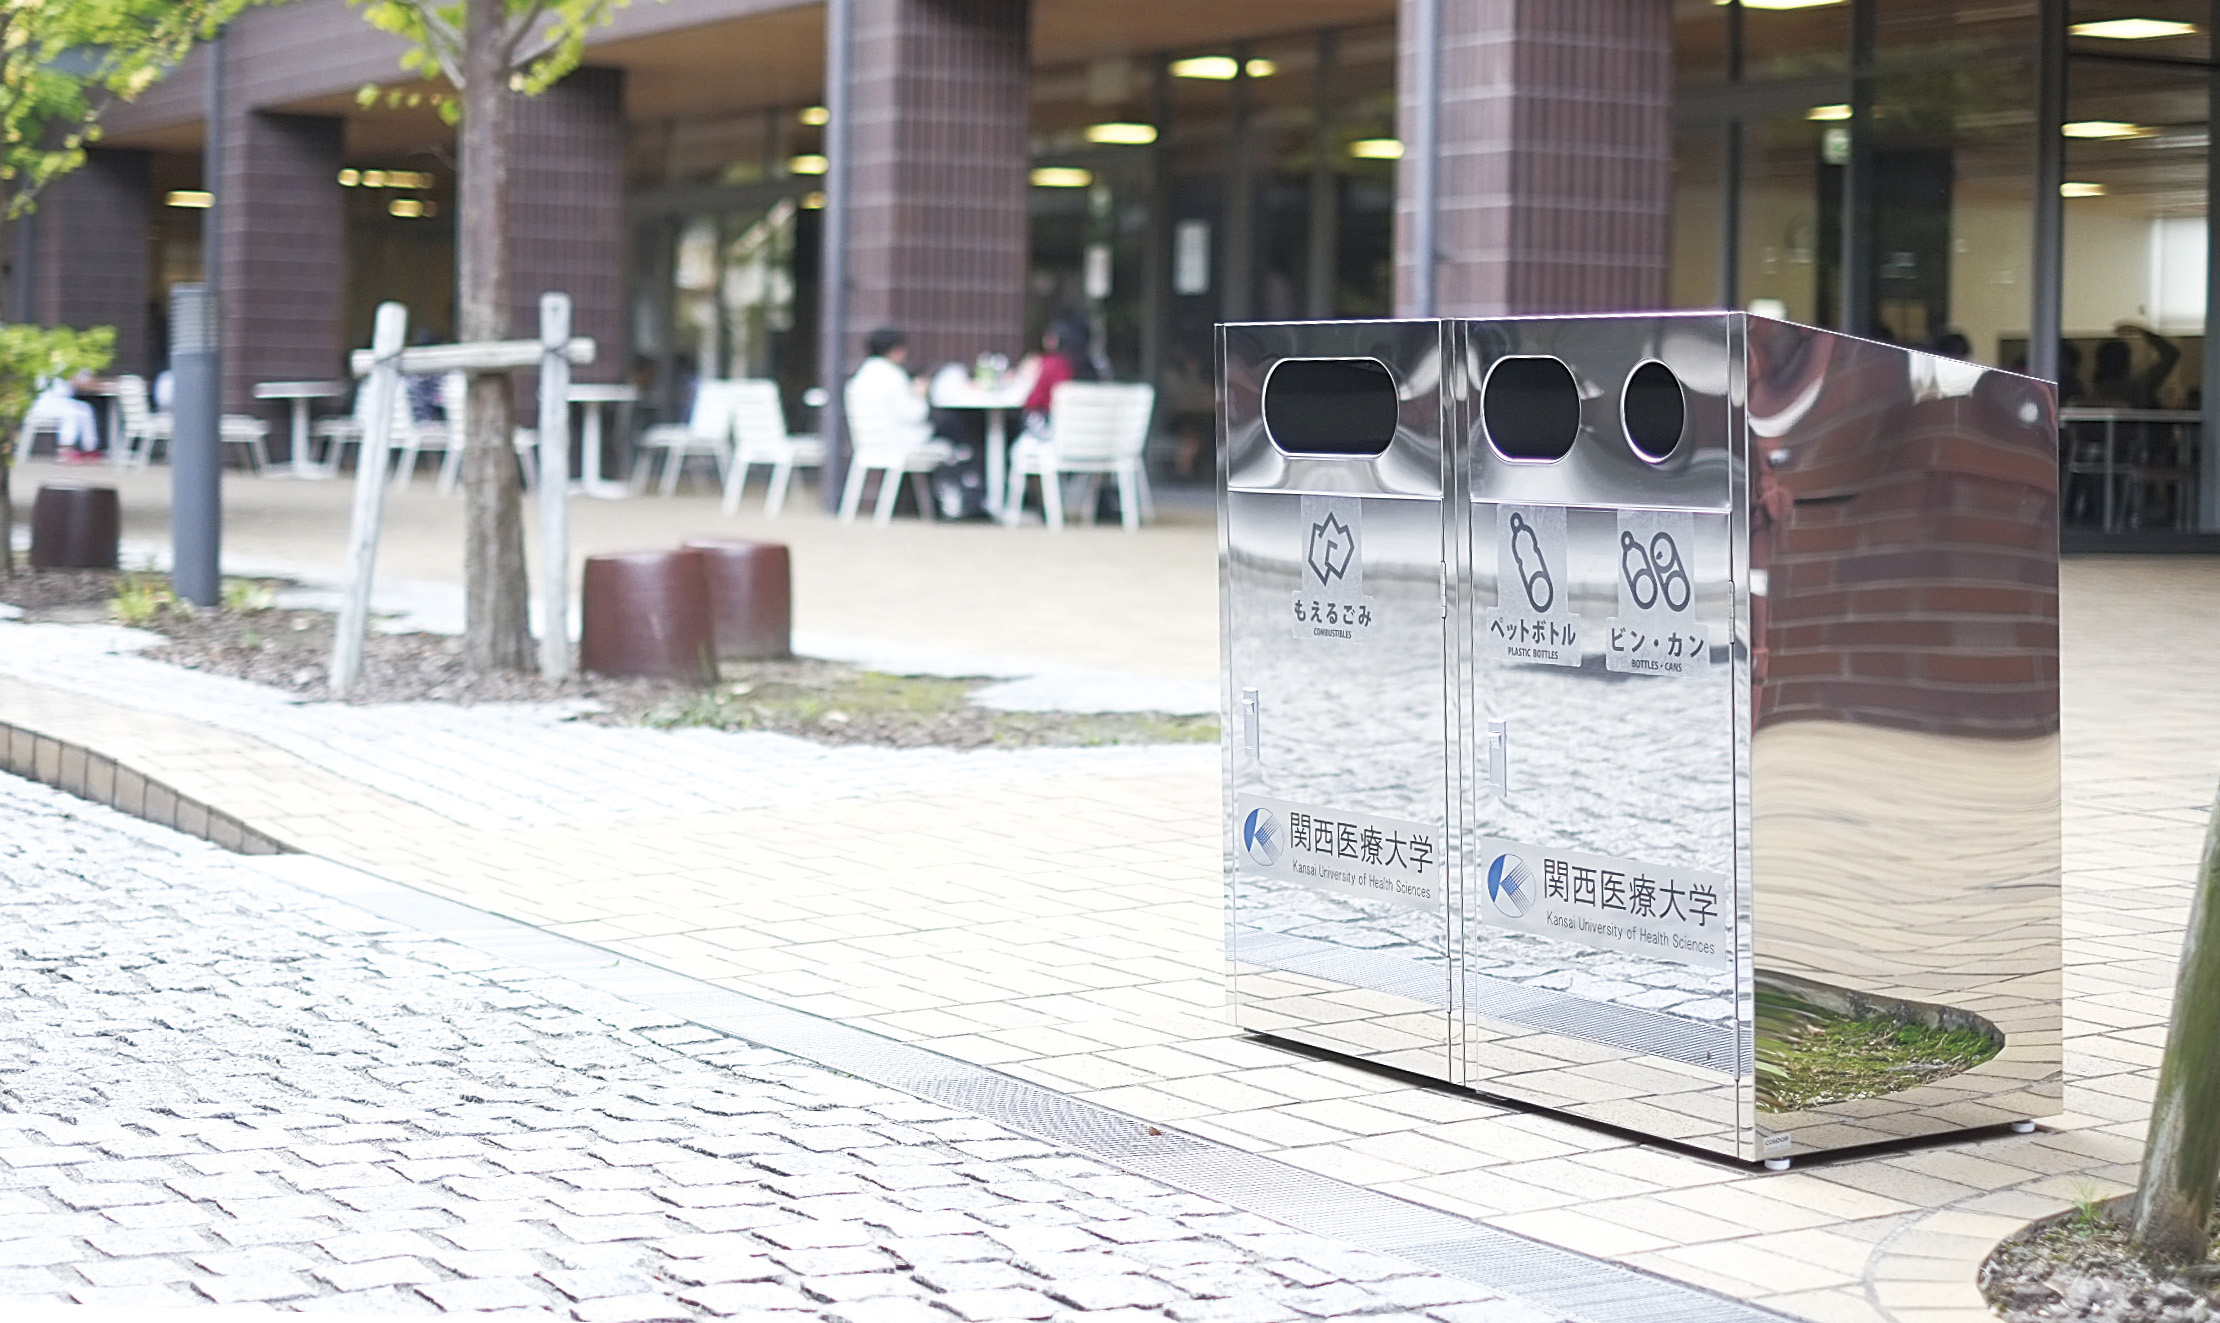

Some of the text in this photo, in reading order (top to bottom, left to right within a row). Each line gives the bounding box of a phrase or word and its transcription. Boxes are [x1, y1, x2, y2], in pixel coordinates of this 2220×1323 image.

[1294, 599, 1372, 628] もえるごみ
[1313, 627, 1352, 639] COMBUSTIBLES
[1490, 616, 1577, 647] ペットボトル
[1611, 627, 1704, 658] ビン・カン
[1508, 646, 1559, 660] PLASTIC BOTTLES
[1290, 812, 1433, 873] 関西医療大学
[1292, 859, 1432, 899] Kansai University of Health Sciences
[1543, 858, 1718, 927] 関西医療大学
[1546, 911, 1716, 955] Kansai University of Health Sciences
